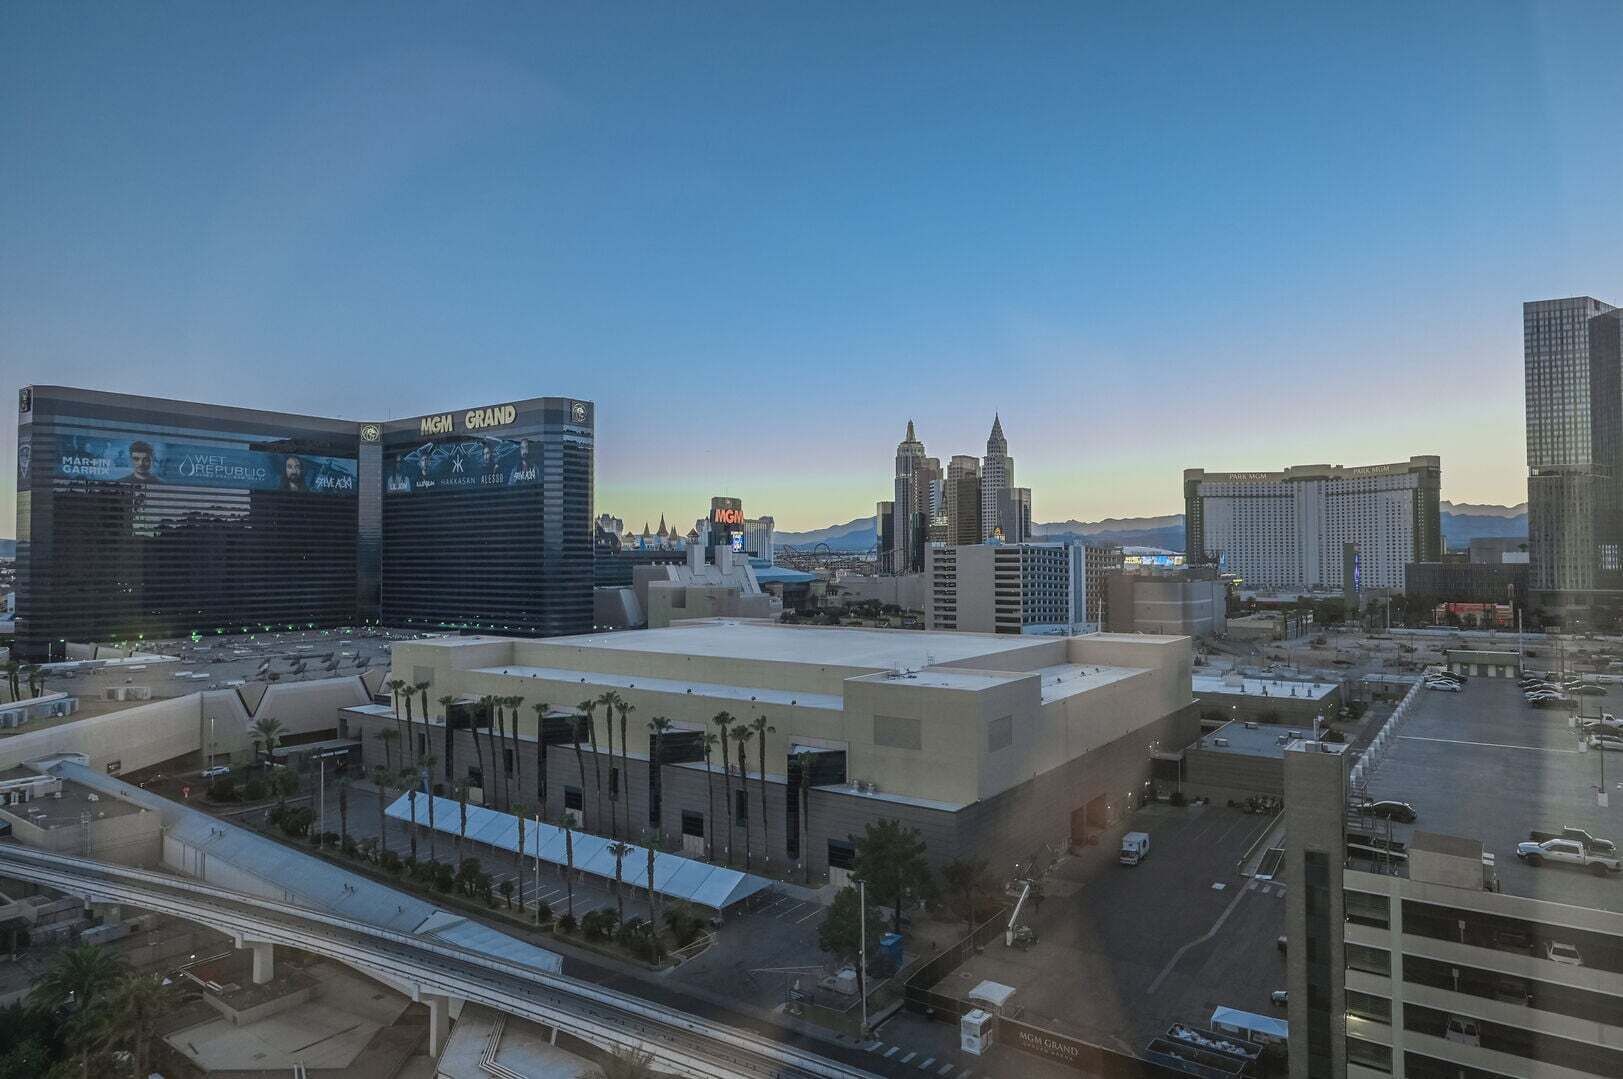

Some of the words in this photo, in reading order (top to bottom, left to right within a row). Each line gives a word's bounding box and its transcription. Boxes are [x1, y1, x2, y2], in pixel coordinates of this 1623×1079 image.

[420, 414, 453, 436] MGM
[465, 405, 516, 429] GRAND
[62, 456, 111, 467] MARTIN
[194, 455, 227, 465] WET
[195, 463, 266, 477] REPUBLIC
[715, 508, 745, 525] MGM
[1019, 1031, 1042, 1046] MGM
[1043, 1039, 1080, 1057] GRAND
